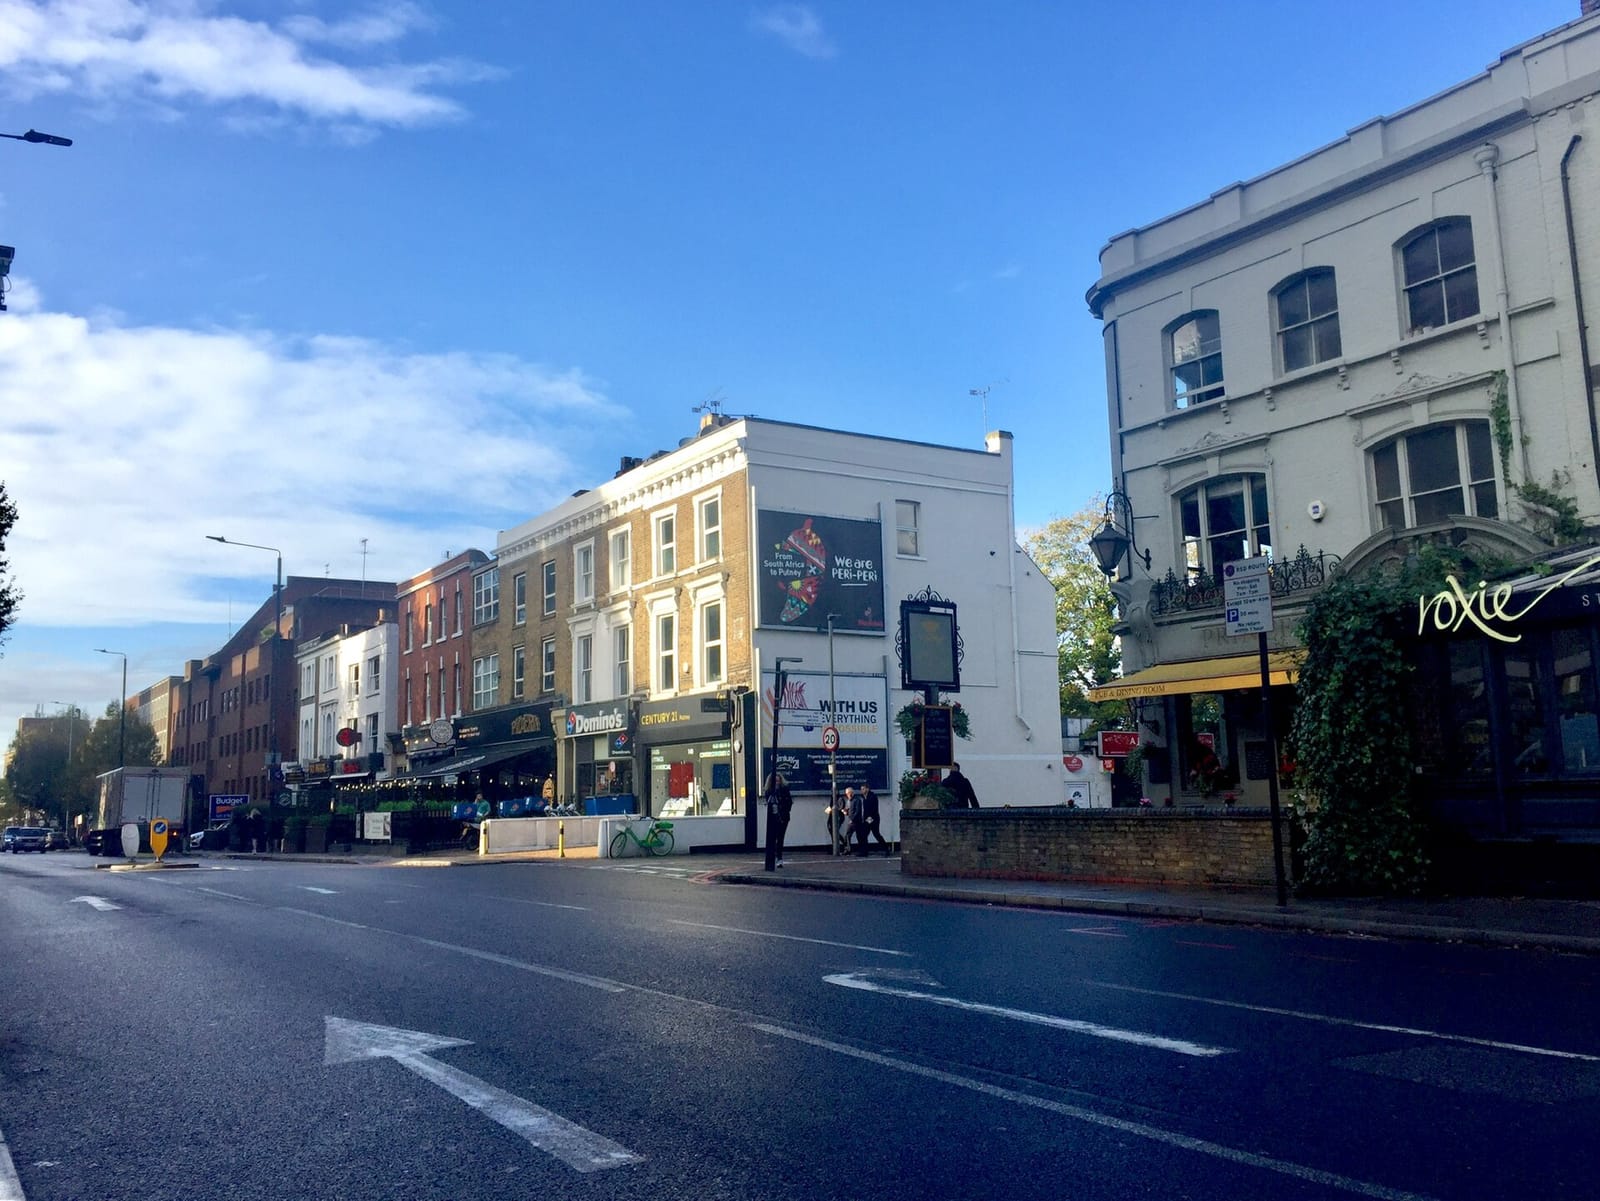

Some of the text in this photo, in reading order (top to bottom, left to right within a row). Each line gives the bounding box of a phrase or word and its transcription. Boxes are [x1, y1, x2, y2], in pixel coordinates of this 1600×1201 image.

[775, 552, 792, 560] From
[764, 560, 783, 568] South
[835, 555, 873, 569] We are
[779, 568, 801, 577] Putney
[1116, 687, 1140, 697] DINING
[1142, 685, 1166, 695] ROOM
[819, 700, 878, 713] WITH US
[576, 708, 622, 732] Domino's
[641, 712, 671, 725] CENTURY
[671, 711, 678, 722] 21
[836, 724, 878, 733] OSSIBLE
[825, 734, 835, 744] 20
[215, 797, 243, 806] Budget
